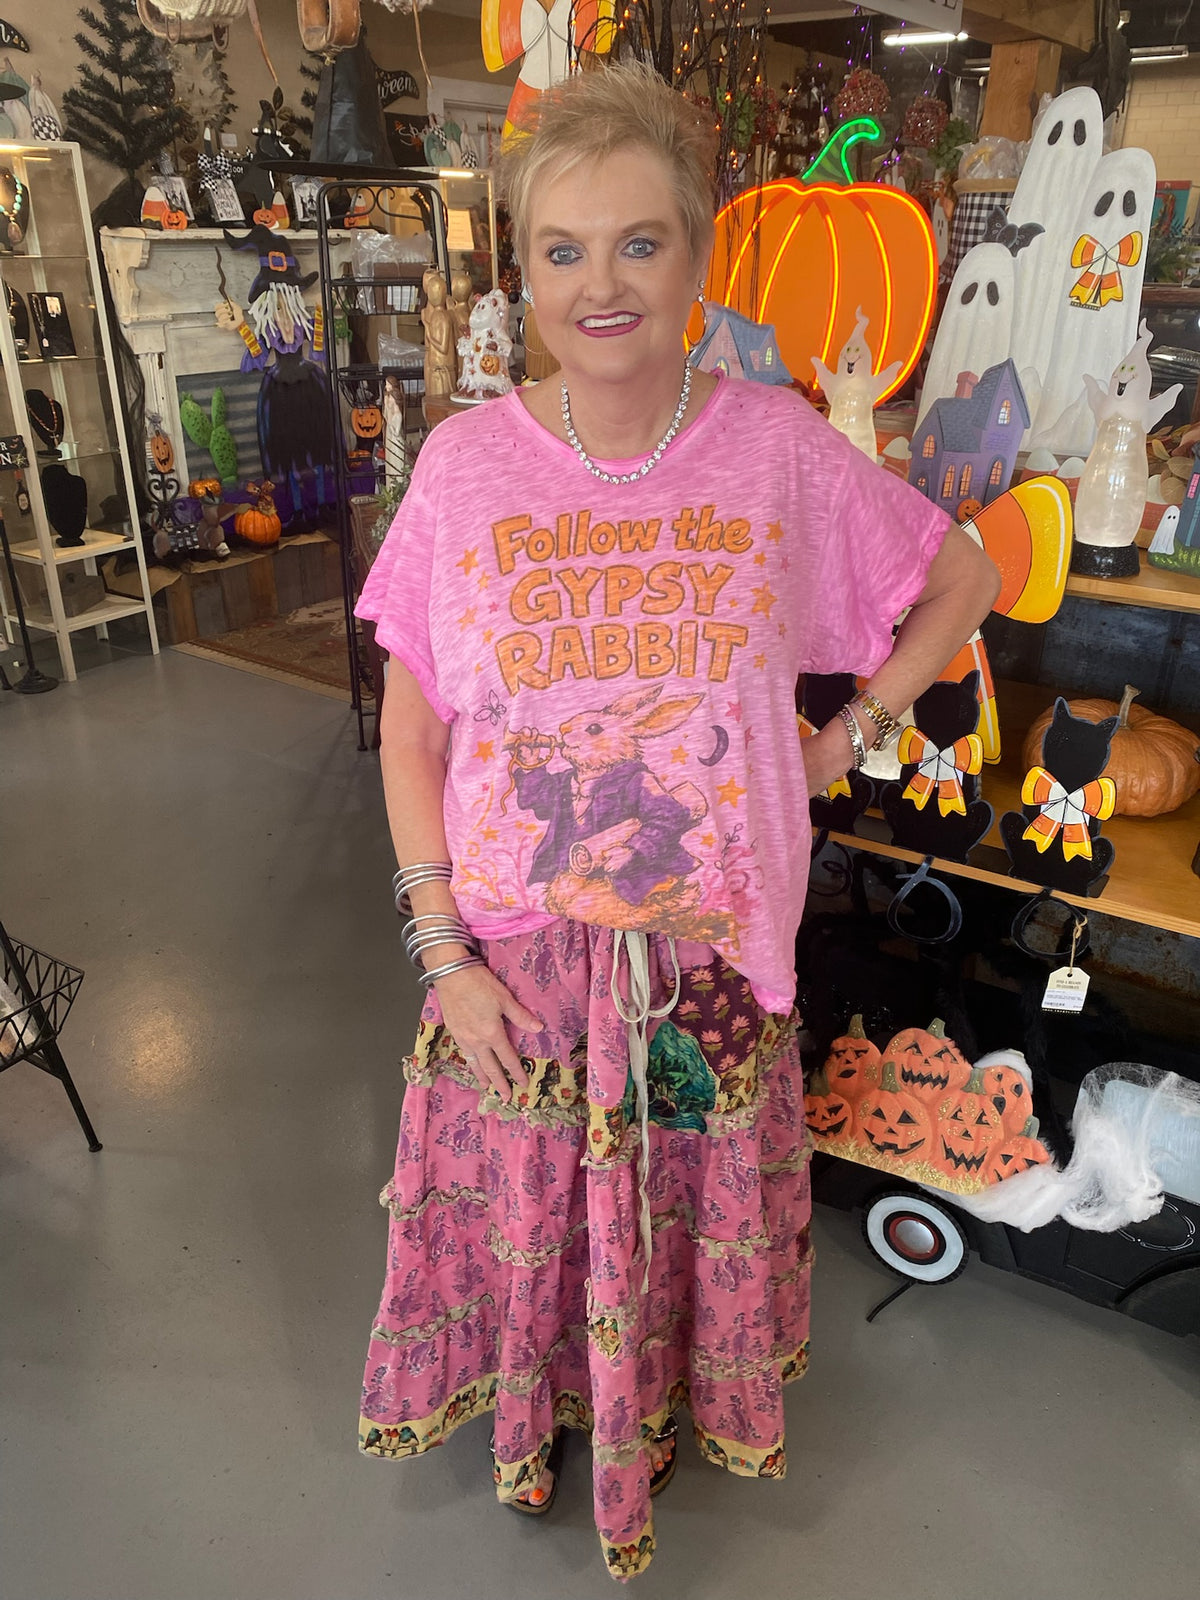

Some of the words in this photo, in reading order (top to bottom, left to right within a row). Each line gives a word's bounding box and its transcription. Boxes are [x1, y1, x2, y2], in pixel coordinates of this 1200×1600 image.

[493, 509, 661, 574] Follow
[672, 505, 752, 553] the
[511, 562, 734, 624] GYPSY
[496, 621, 748, 696] RABBIT
